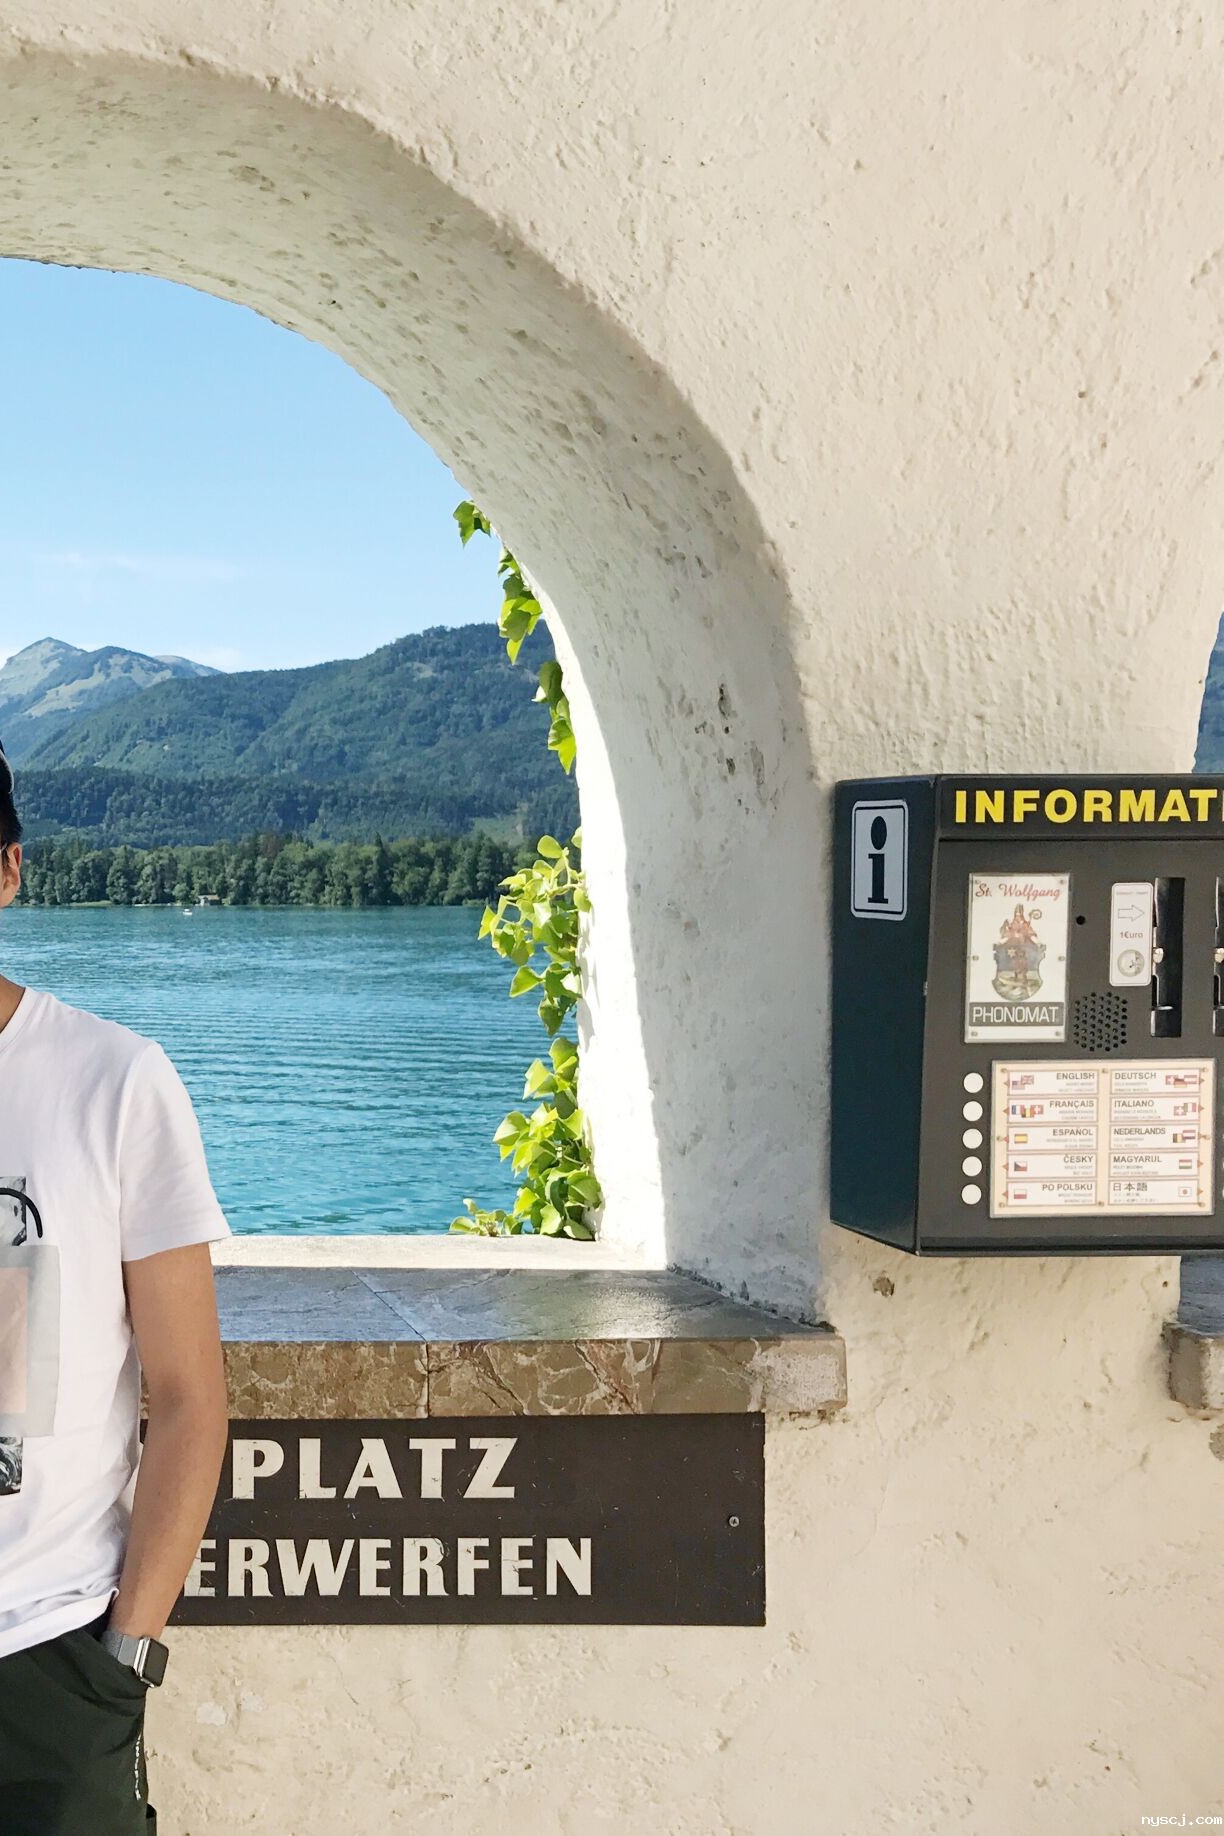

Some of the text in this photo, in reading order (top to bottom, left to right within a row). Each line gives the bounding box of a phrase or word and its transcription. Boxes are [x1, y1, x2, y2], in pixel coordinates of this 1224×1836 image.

[955, 788, 1224, 823] INFORMAT
[998, 883, 1061, 901] Wolfgang
[972, 1006, 1059, 1023] PHONOMAT
[1056, 1072, 1095, 1080] ENGLISH
[1114, 1072, 1157, 1080] DEUTSCH
[1049, 1100, 1095, 1109] FRANÇAIS
[1114, 1099, 1155, 1108] ITALIANO
[1113, 1127, 1166, 1136] NEDERLANDS
[1113, 1155, 1163, 1163] MAGYARUL
[1057, 1183, 1093, 1191] POLSKU
[1112, 1181, 1148, 1192] 日本語
[232, 1438, 518, 1499] PLATZ
[183, 1537, 592, 1598] ERWERFEN
